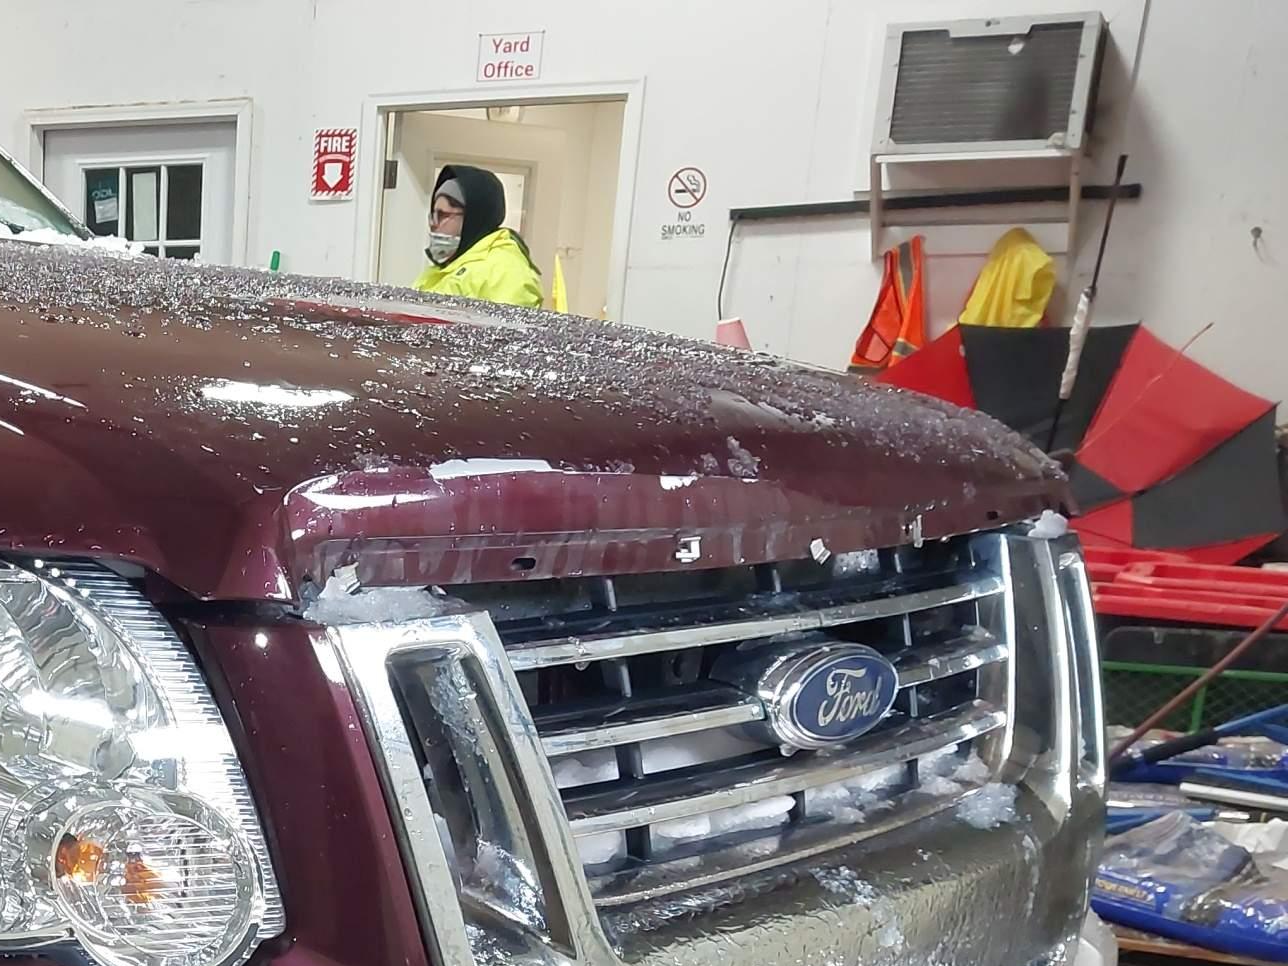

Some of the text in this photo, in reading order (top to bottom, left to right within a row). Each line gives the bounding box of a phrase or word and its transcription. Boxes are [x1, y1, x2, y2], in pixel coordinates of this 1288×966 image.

[492, 34, 530, 54] Yard
[483, 60, 534, 78] Office
[320, 136, 351, 153] FIRE
[677, 210, 692, 222] NO
[661, 223, 705, 236] SMOKING
[817, 667, 883, 727] Ford
